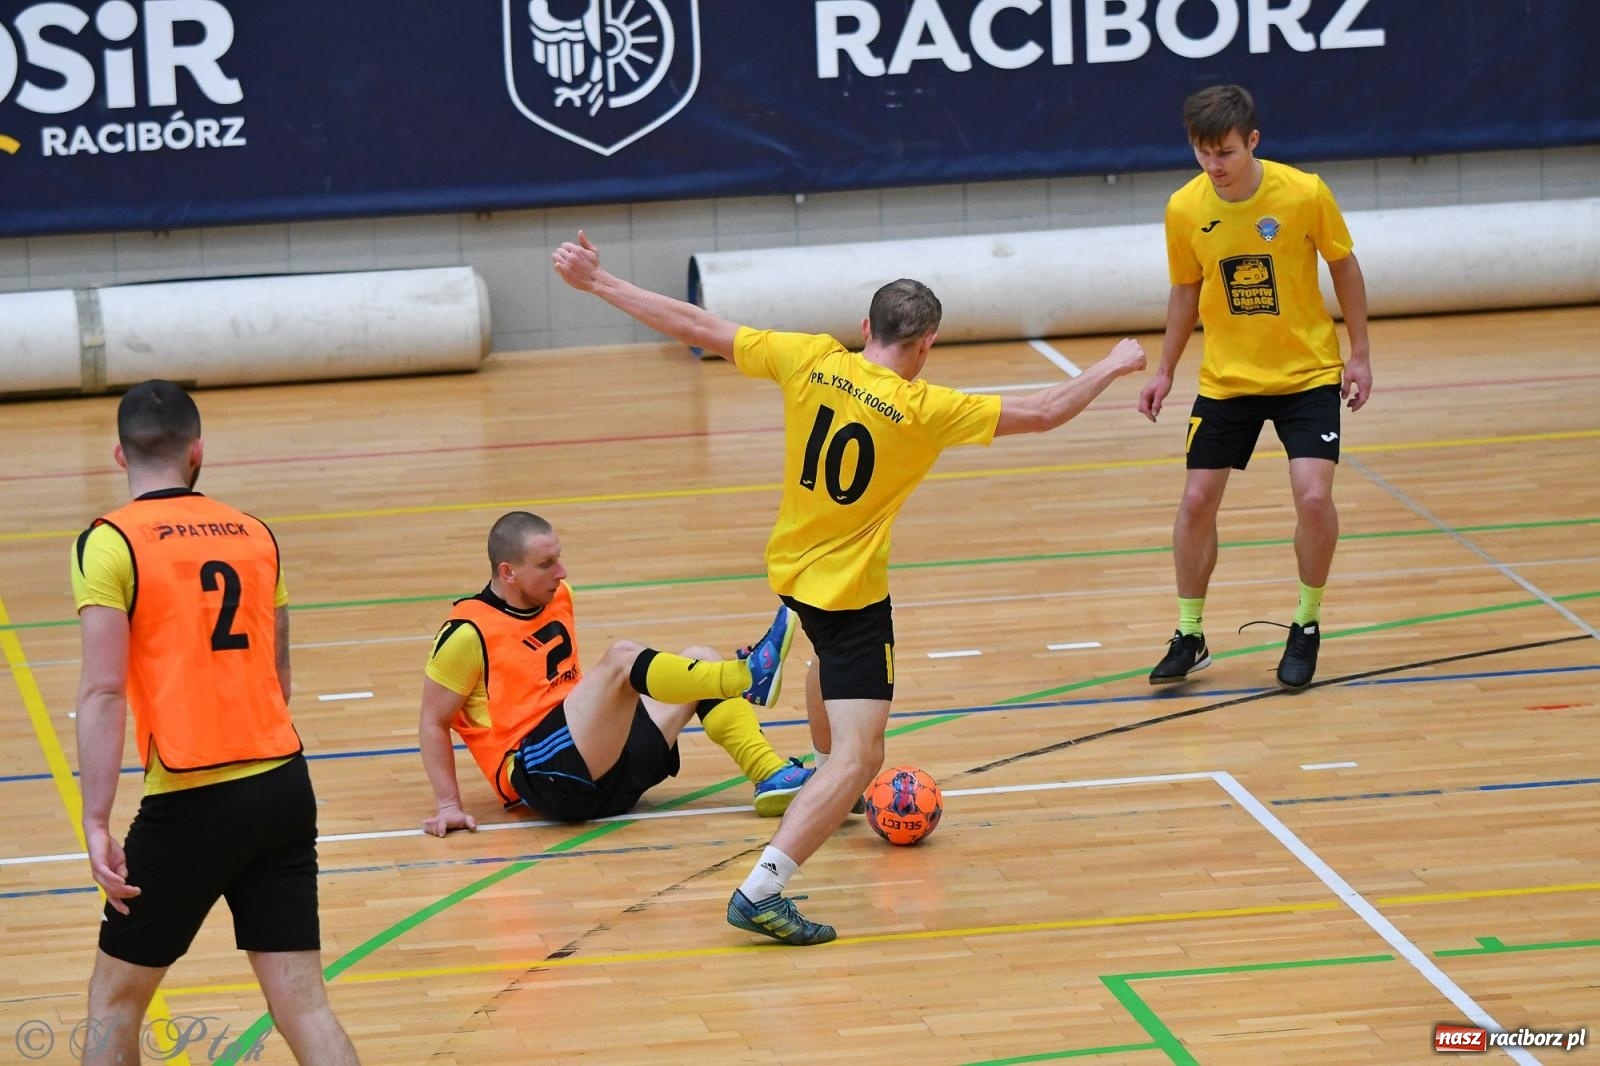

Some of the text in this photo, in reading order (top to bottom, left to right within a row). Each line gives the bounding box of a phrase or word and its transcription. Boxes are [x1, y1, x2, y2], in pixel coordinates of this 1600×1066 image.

[0, 0, 243, 114] SiR
[41, 110, 246, 156] RACIBÓRZ
[864, 393, 904, 424] ROGÓW
[799, 404, 875, 505] 10
[175, 522, 249, 537] PATRICK
[200, 560, 249, 651] 2
[882, 817, 921, 830] SELECT
